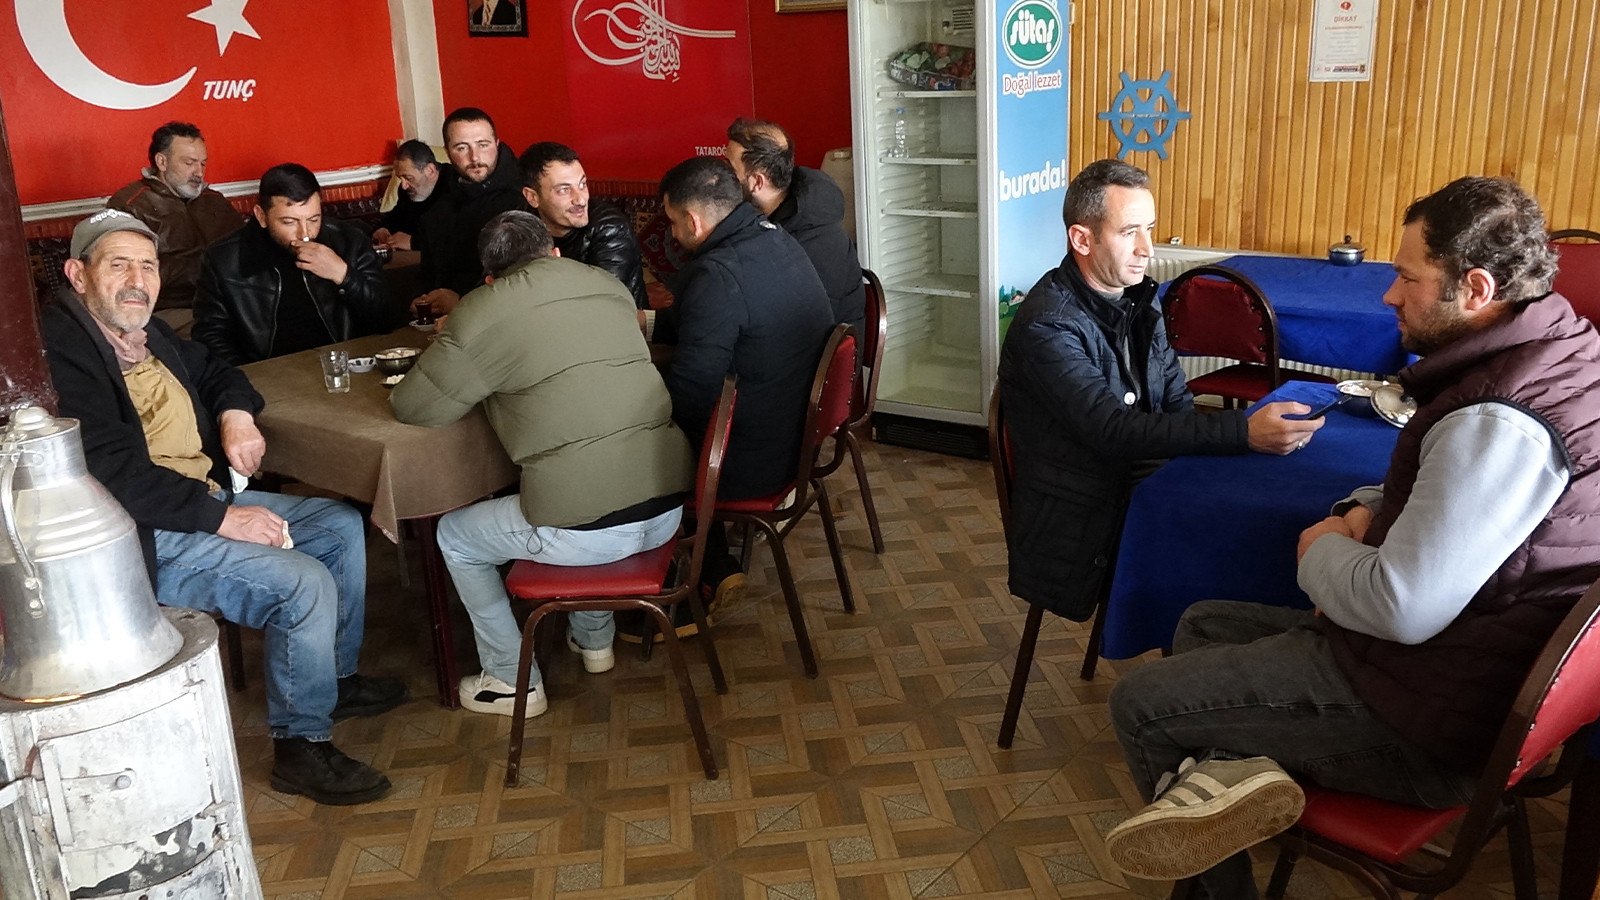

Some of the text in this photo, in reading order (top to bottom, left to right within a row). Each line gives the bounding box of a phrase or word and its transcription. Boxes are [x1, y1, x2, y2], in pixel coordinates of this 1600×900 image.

[1010, 9, 1055, 52] sütaş
[203, 79, 256, 102] TUNÇ
[1004, 72, 1061, 96] Doğal lezzet
[695, 144, 727, 156] TATAROĞ
[999, 158, 1066, 202] burada!
